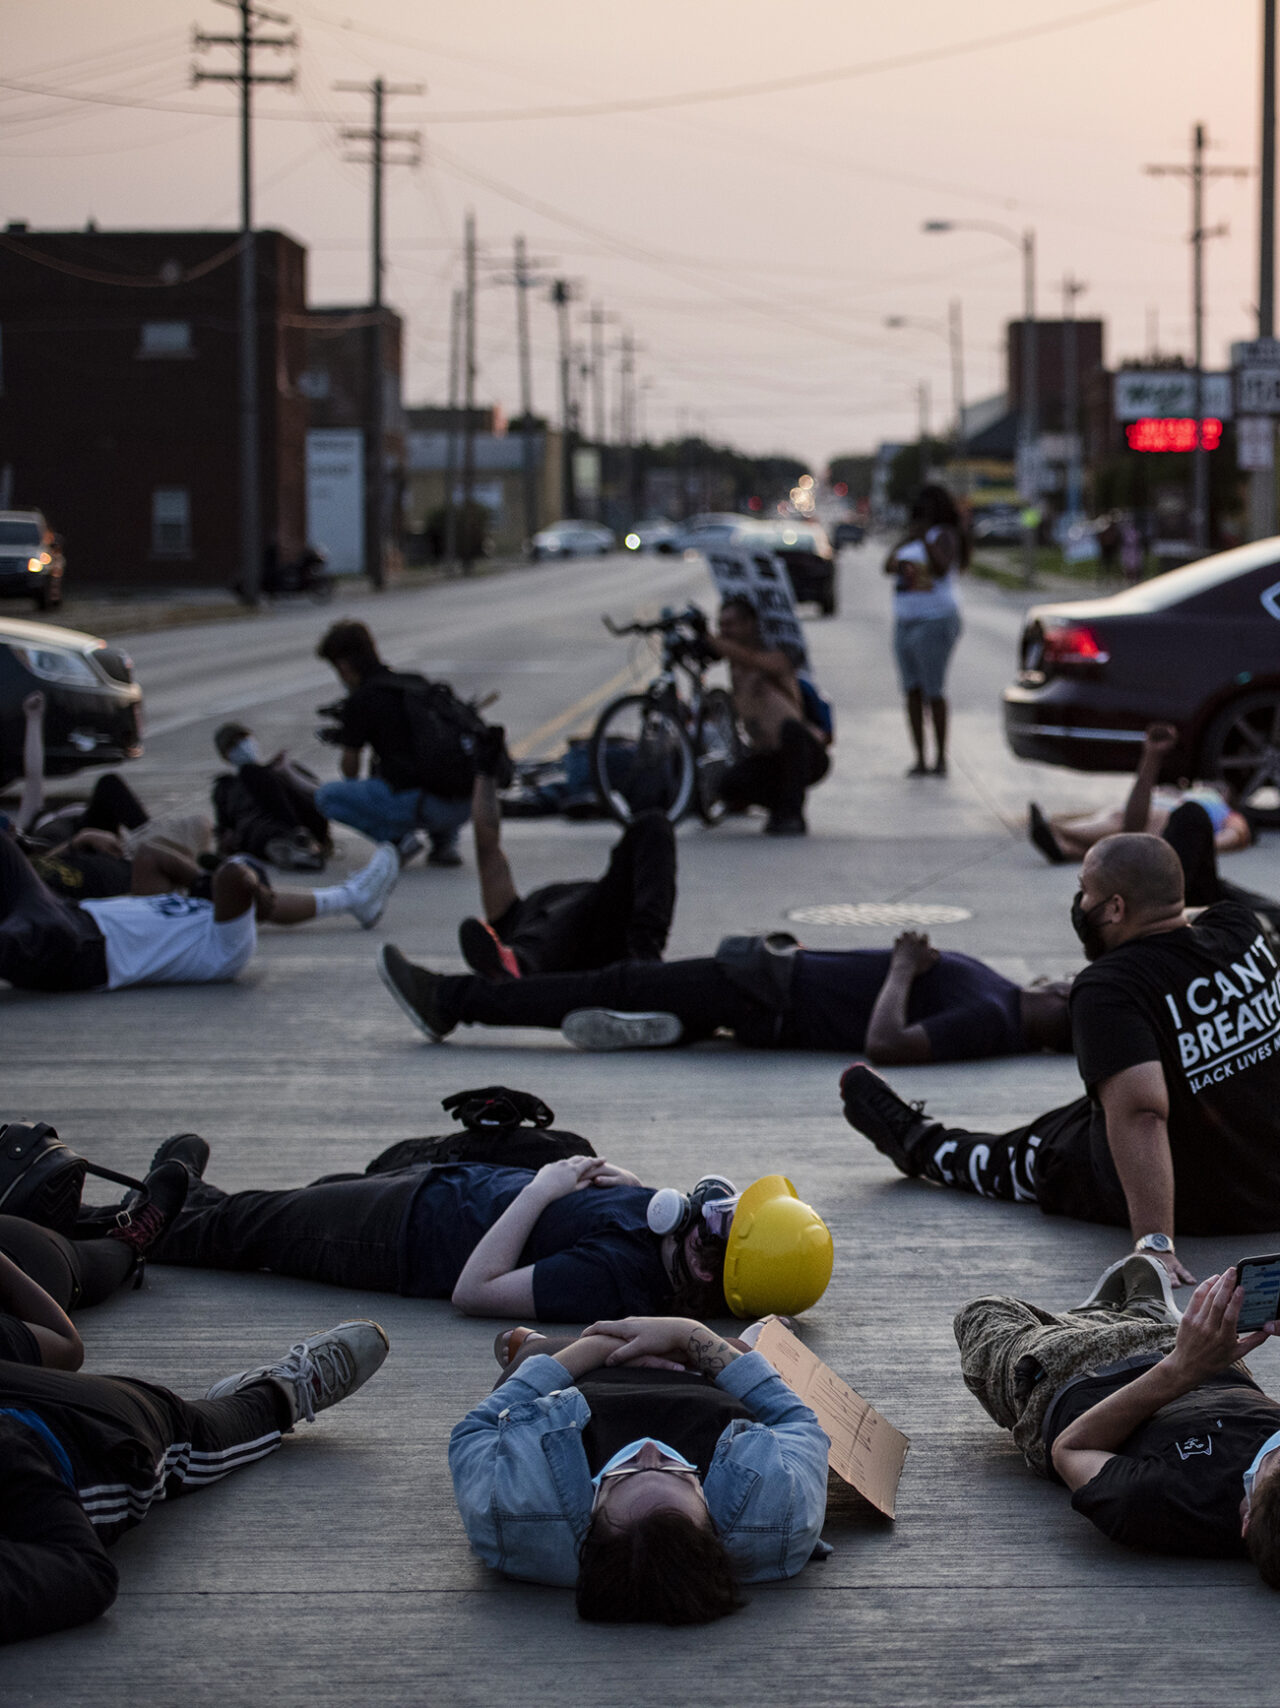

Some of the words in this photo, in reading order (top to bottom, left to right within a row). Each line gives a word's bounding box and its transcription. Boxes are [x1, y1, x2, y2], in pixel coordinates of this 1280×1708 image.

[1164, 993, 1183, 1030] I
[1186, 934, 1278, 1016] CAN'T
[1236, 1043, 1272, 1071] LIVES
